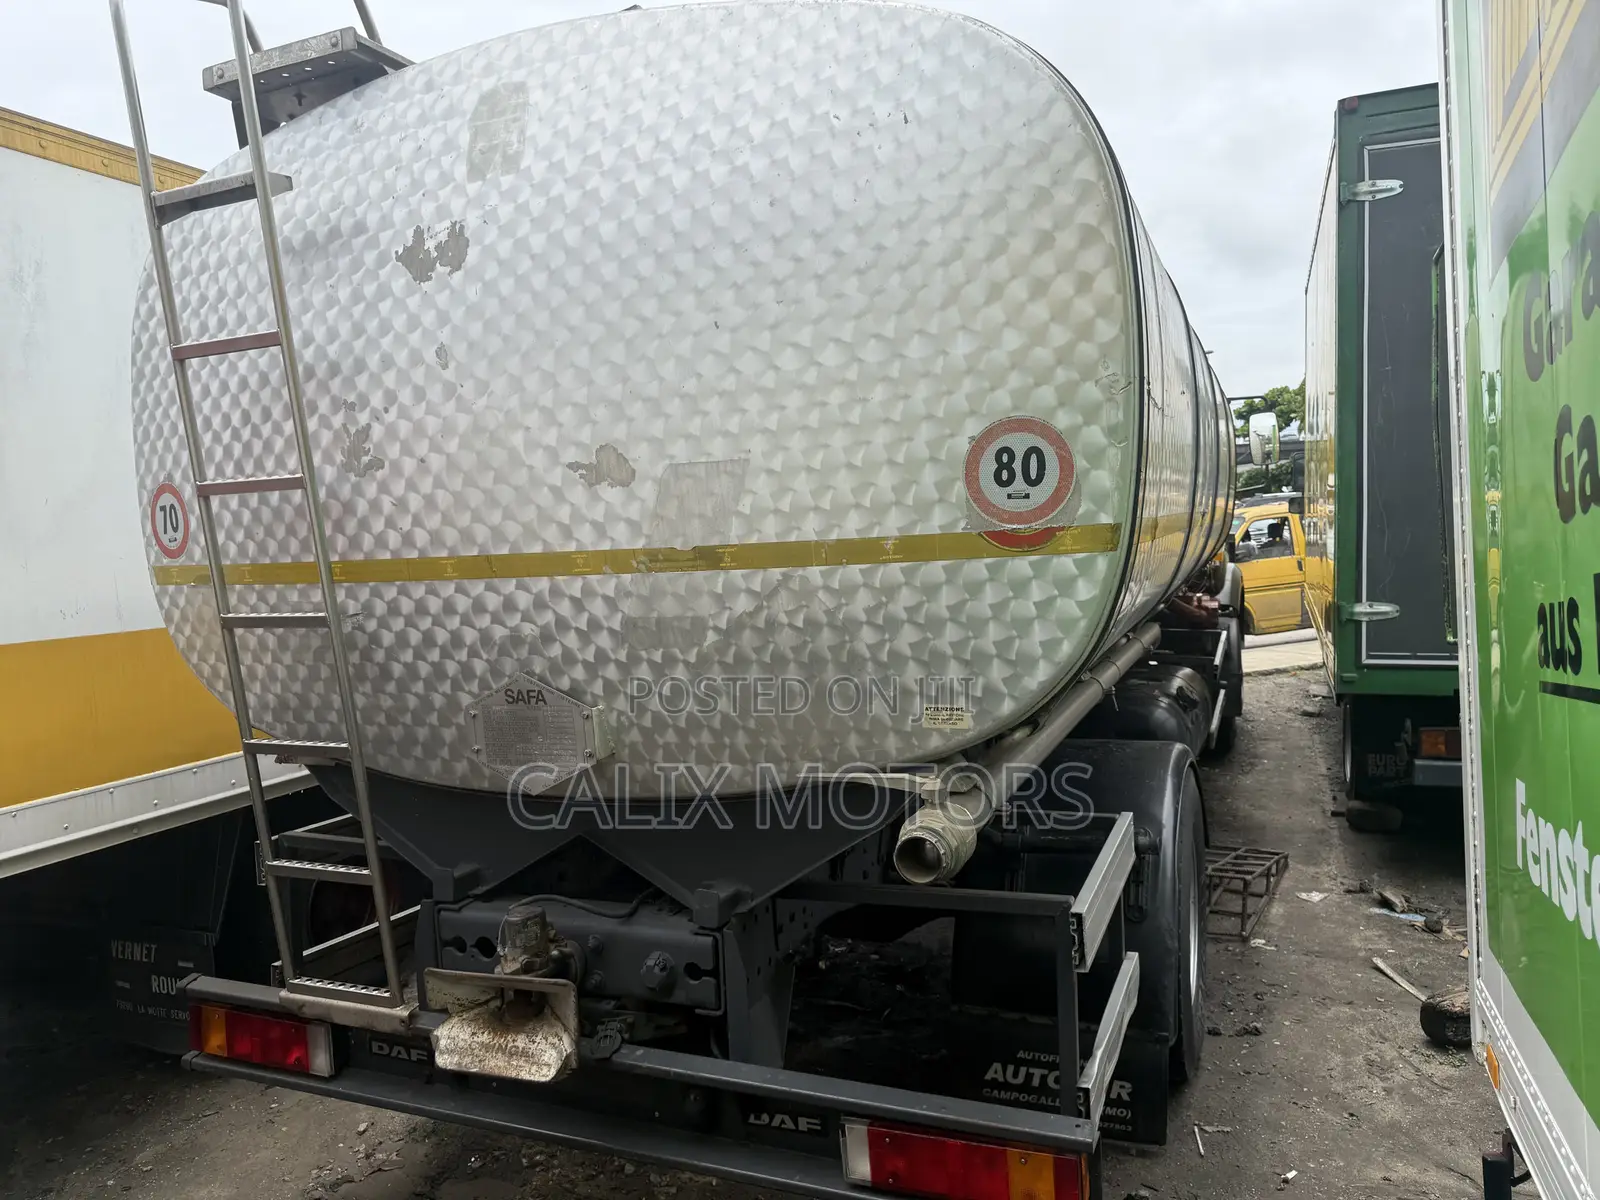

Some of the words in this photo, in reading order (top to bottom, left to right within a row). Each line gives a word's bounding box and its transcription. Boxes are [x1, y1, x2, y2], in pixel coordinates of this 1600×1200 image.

[993, 445, 1047, 488] 80
[159, 503, 179, 535] 70
[1537, 597, 1582, 676] aus
[504, 688, 548, 706] SAFA
[111, 939, 158, 964] VERNET
[151, 974, 182, 996] ROU
[372, 1041, 428, 1062] DAF
[747, 1112, 822, 1132] DAF
